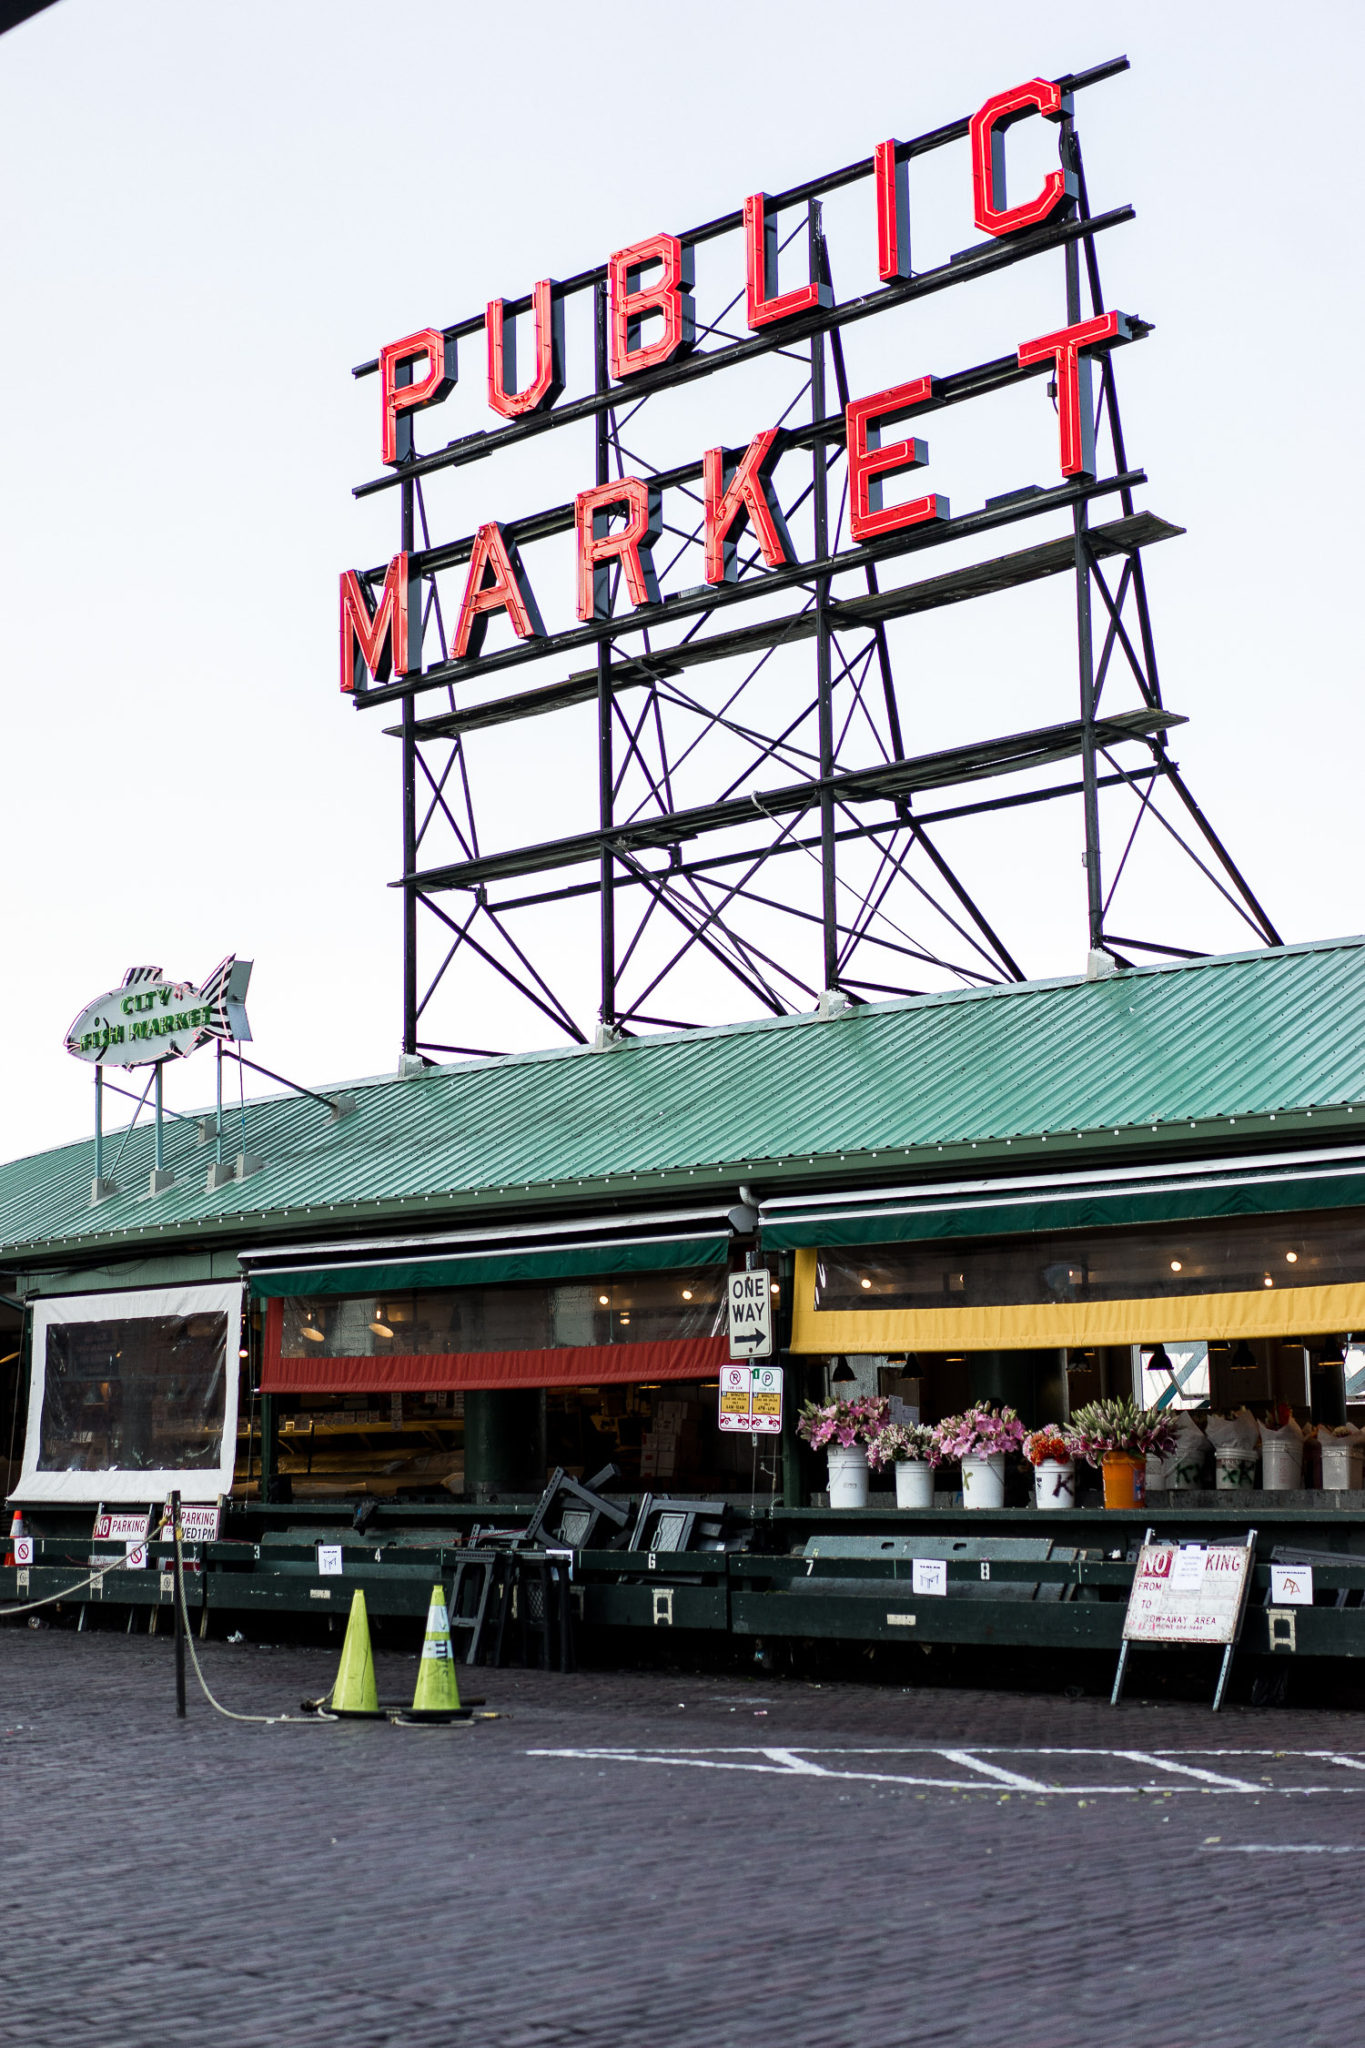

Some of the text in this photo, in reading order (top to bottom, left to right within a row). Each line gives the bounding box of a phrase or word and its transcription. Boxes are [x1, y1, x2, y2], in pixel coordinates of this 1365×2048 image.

[379, 76, 1078, 467] PUBLIC
[339, 310, 1133, 694] MARKET
[120, 986, 173, 1016] CITY
[80, 1005, 214, 1052] FISH MARKET
[733, 1277, 764, 1299] ONE
[732, 1302, 765, 1323] WAY
[1052, 1473, 1074, 1498] K
[95, 1516, 145, 1536] NO PARKING
[181, 1511, 216, 1526] PARKING
[254, 1545, 261, 1560] 3
[374, 1548, 382, 1563] 4
[1142, 1549, 1169, 1575] NO
[1204, 1553, 1241, 1572] KING
[805, 1559, 815, 1576] 7
[980, 1562, 990, 1580] 8
[1138, 1582, 1162, 1591] FROM
[1141, 1599, 1152, 1609] TO
[1193, 1617, 1217, 1625] AREA
